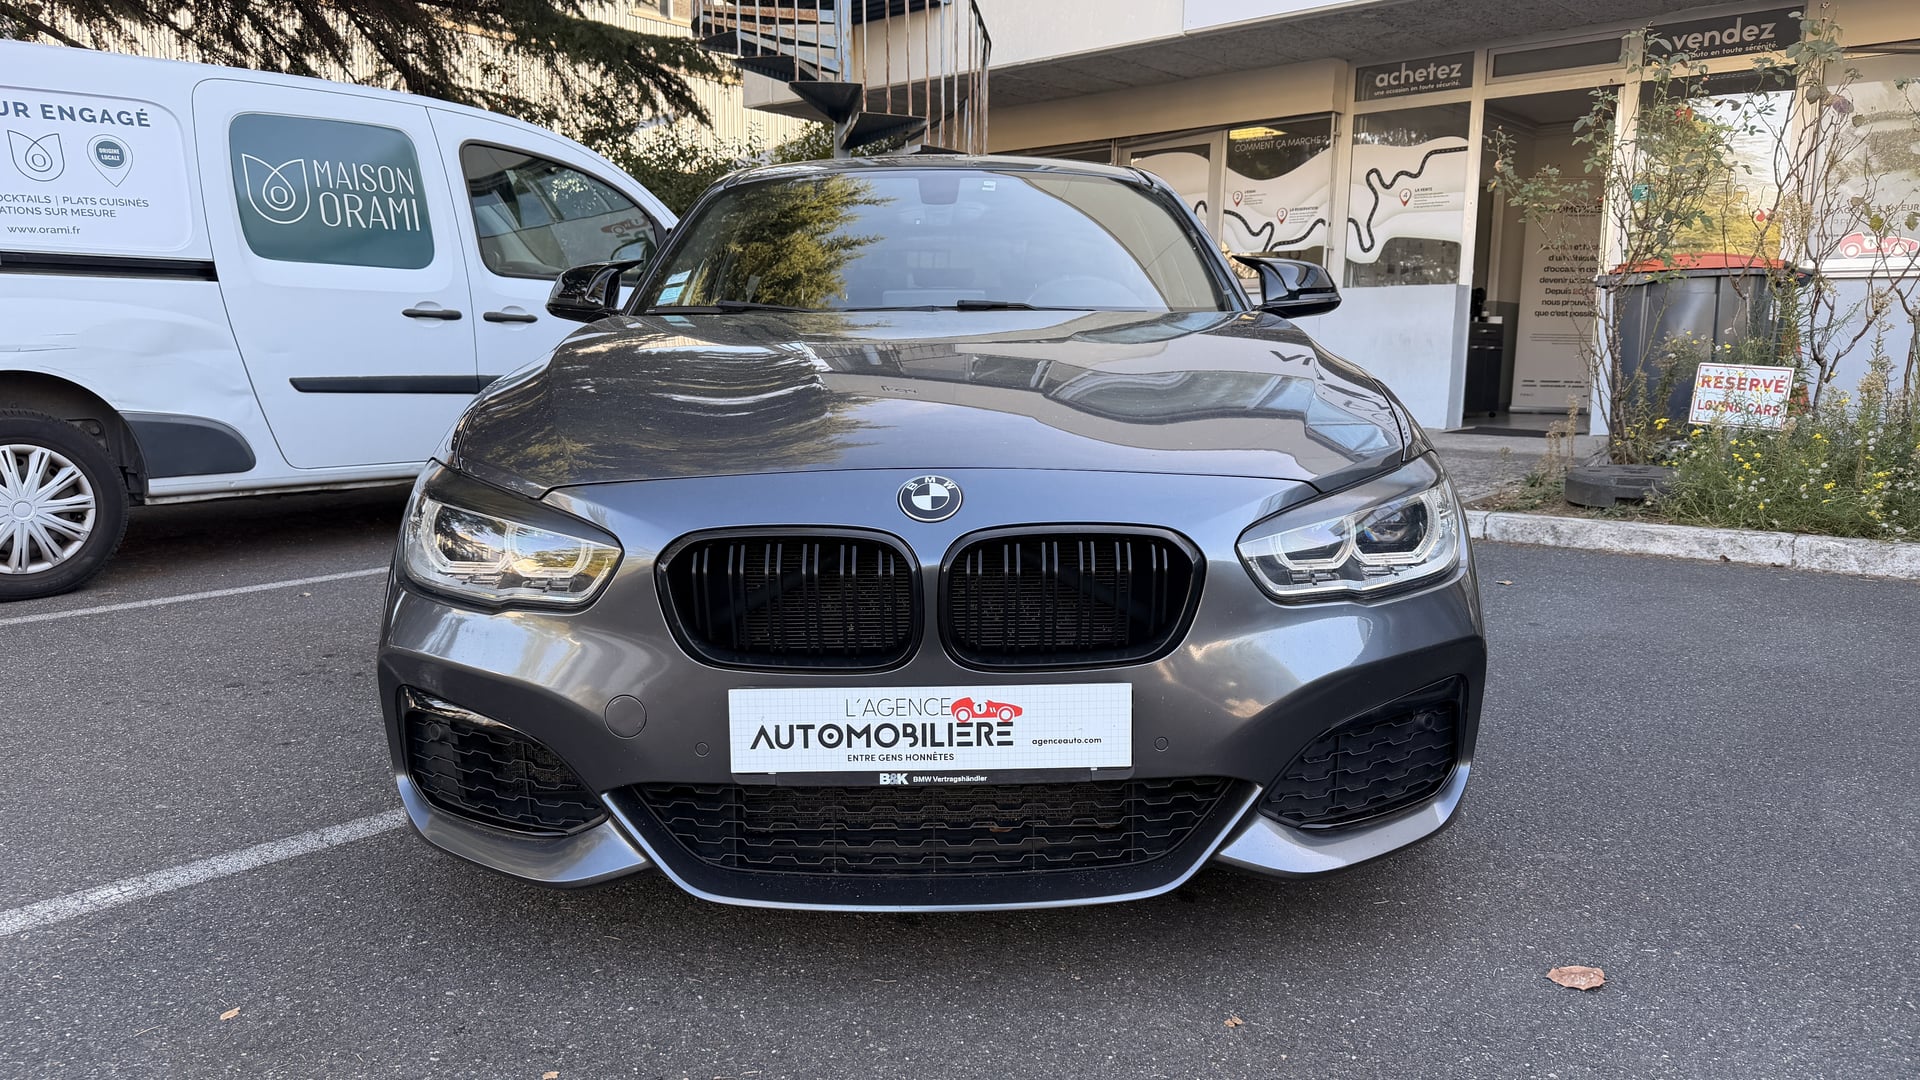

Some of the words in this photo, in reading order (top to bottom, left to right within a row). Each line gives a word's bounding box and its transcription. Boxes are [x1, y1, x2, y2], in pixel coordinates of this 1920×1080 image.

[1672, 16, 1777, 50] vendez
[1722, 47, 1743, 55] toute
[1375, 62, 1462, 87] achetez
[40, 103, 151, 128] ENGAGÉ
[1235, 141, 1274, 153] COMMENT
[1276, 140, 1287, 150] ÇA
[1288, 136, 1321, 146] MARCHE
[313, 159, 415, 195] MAISON
[62, 196, 97, 206] PLATS
[99, 197, 150, 208] CUISINÉS
[45, 207, 68, 217] SUR
[71, 208, 117, 218] MESURE
[319, 192, 420, 231] ORAMI
[7, 225, 81, 235] www.orami.fr
[1545, 288, 1571, 296] Depuis
[1535, 310, 1549, 318] que
[1569, 309, 1596, 318] possib
[1700, 371, 1786, 394] RÉSERVÉ
[1747, 403, 1780, 417] CARS
[906, 477, 956, 491] BMW
[845, 697, 951, 717] L'AGENCE
[1032, 738, 1102, 747] agenceauto.com
[847, 754, 876, 762] ENTRE
[878, 753, 903, 762] GENS
[905, 751, 955, 761] HONNÊTES
[879, 773, 909, 785] B&K
[933, 775, 988, 784] Vertragshändler
